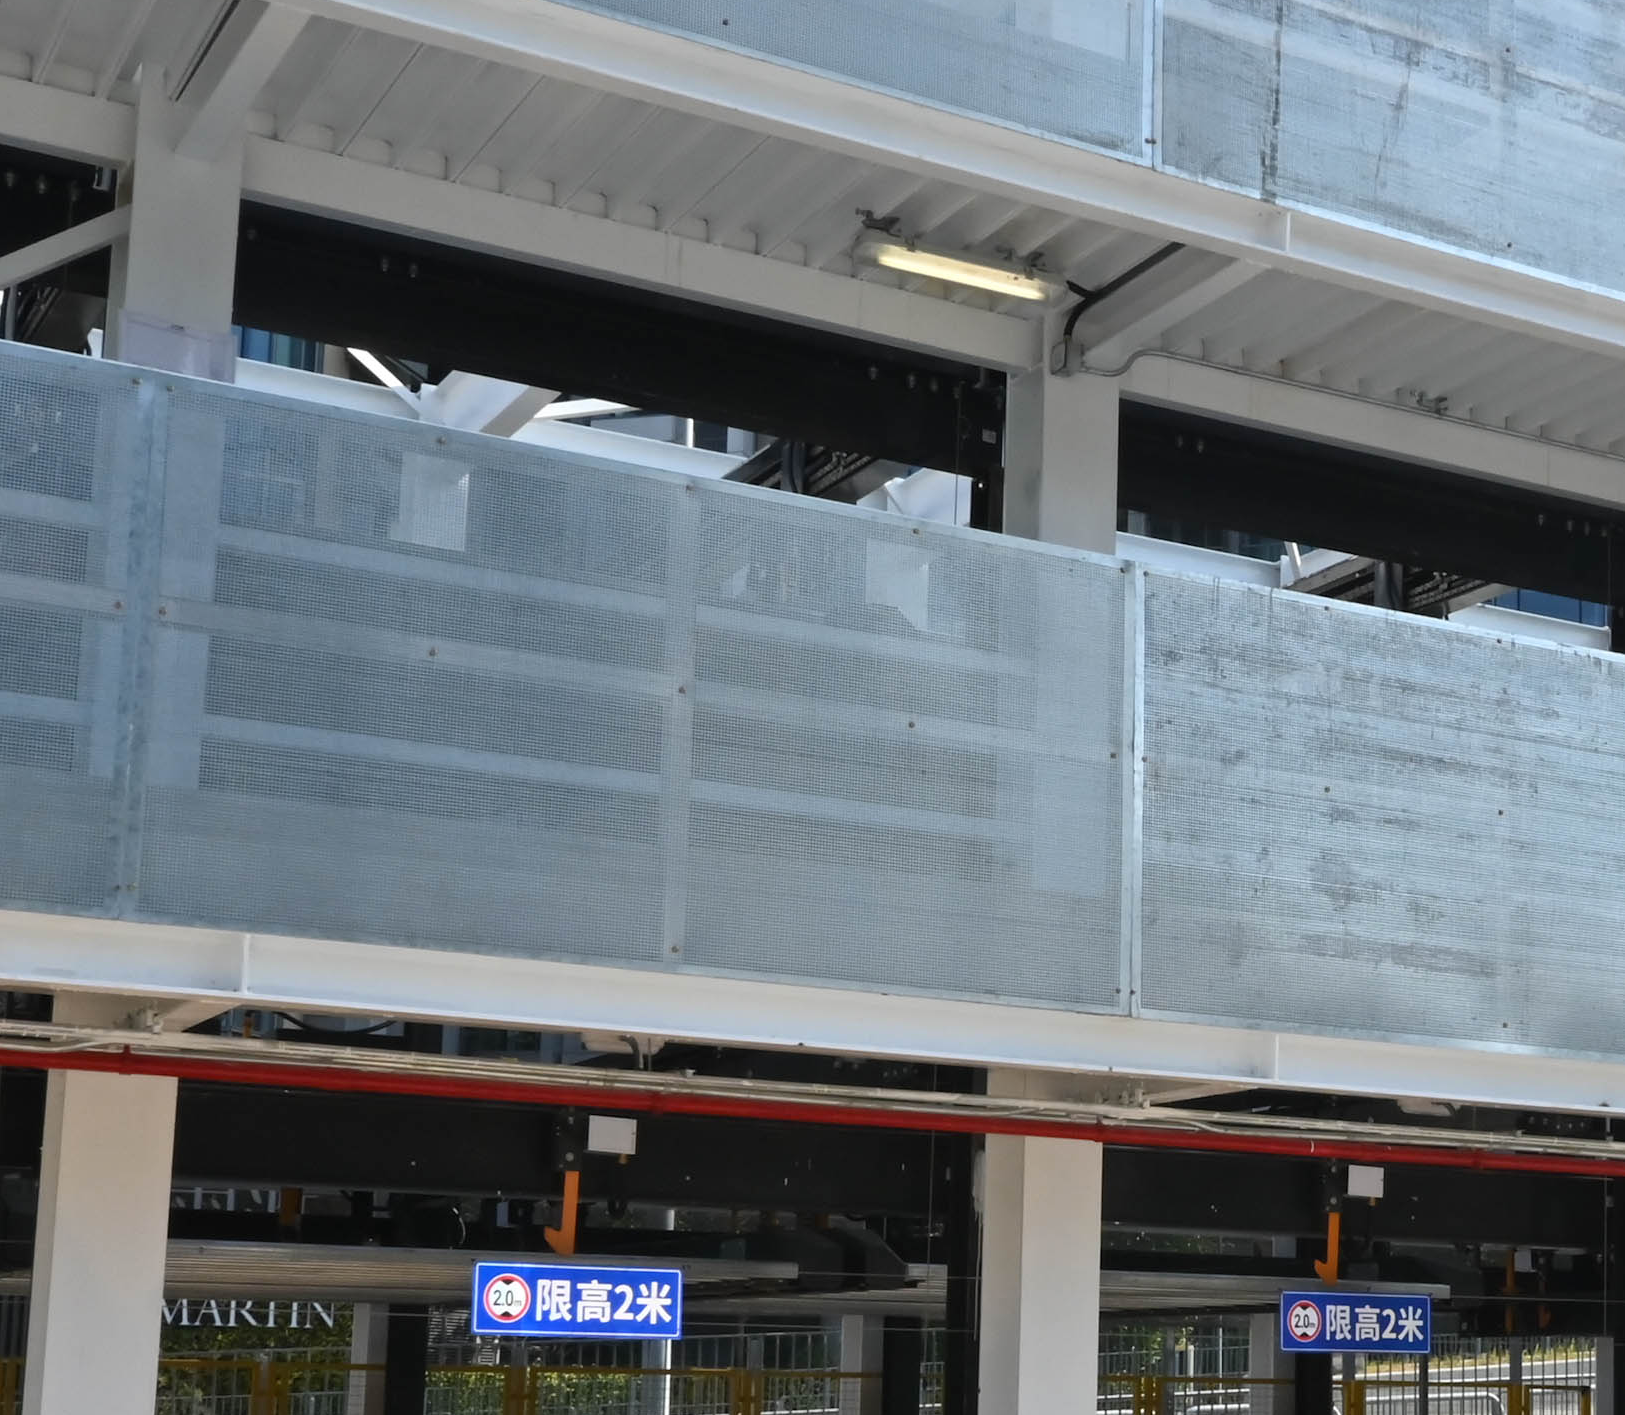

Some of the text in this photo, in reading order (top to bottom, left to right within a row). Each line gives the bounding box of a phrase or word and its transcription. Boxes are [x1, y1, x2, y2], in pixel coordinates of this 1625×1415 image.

[493, 1279, 673, 1325] 2.0m 限高2米
[1294, 1304, 1425, 1343] 2.0m 限高2米
